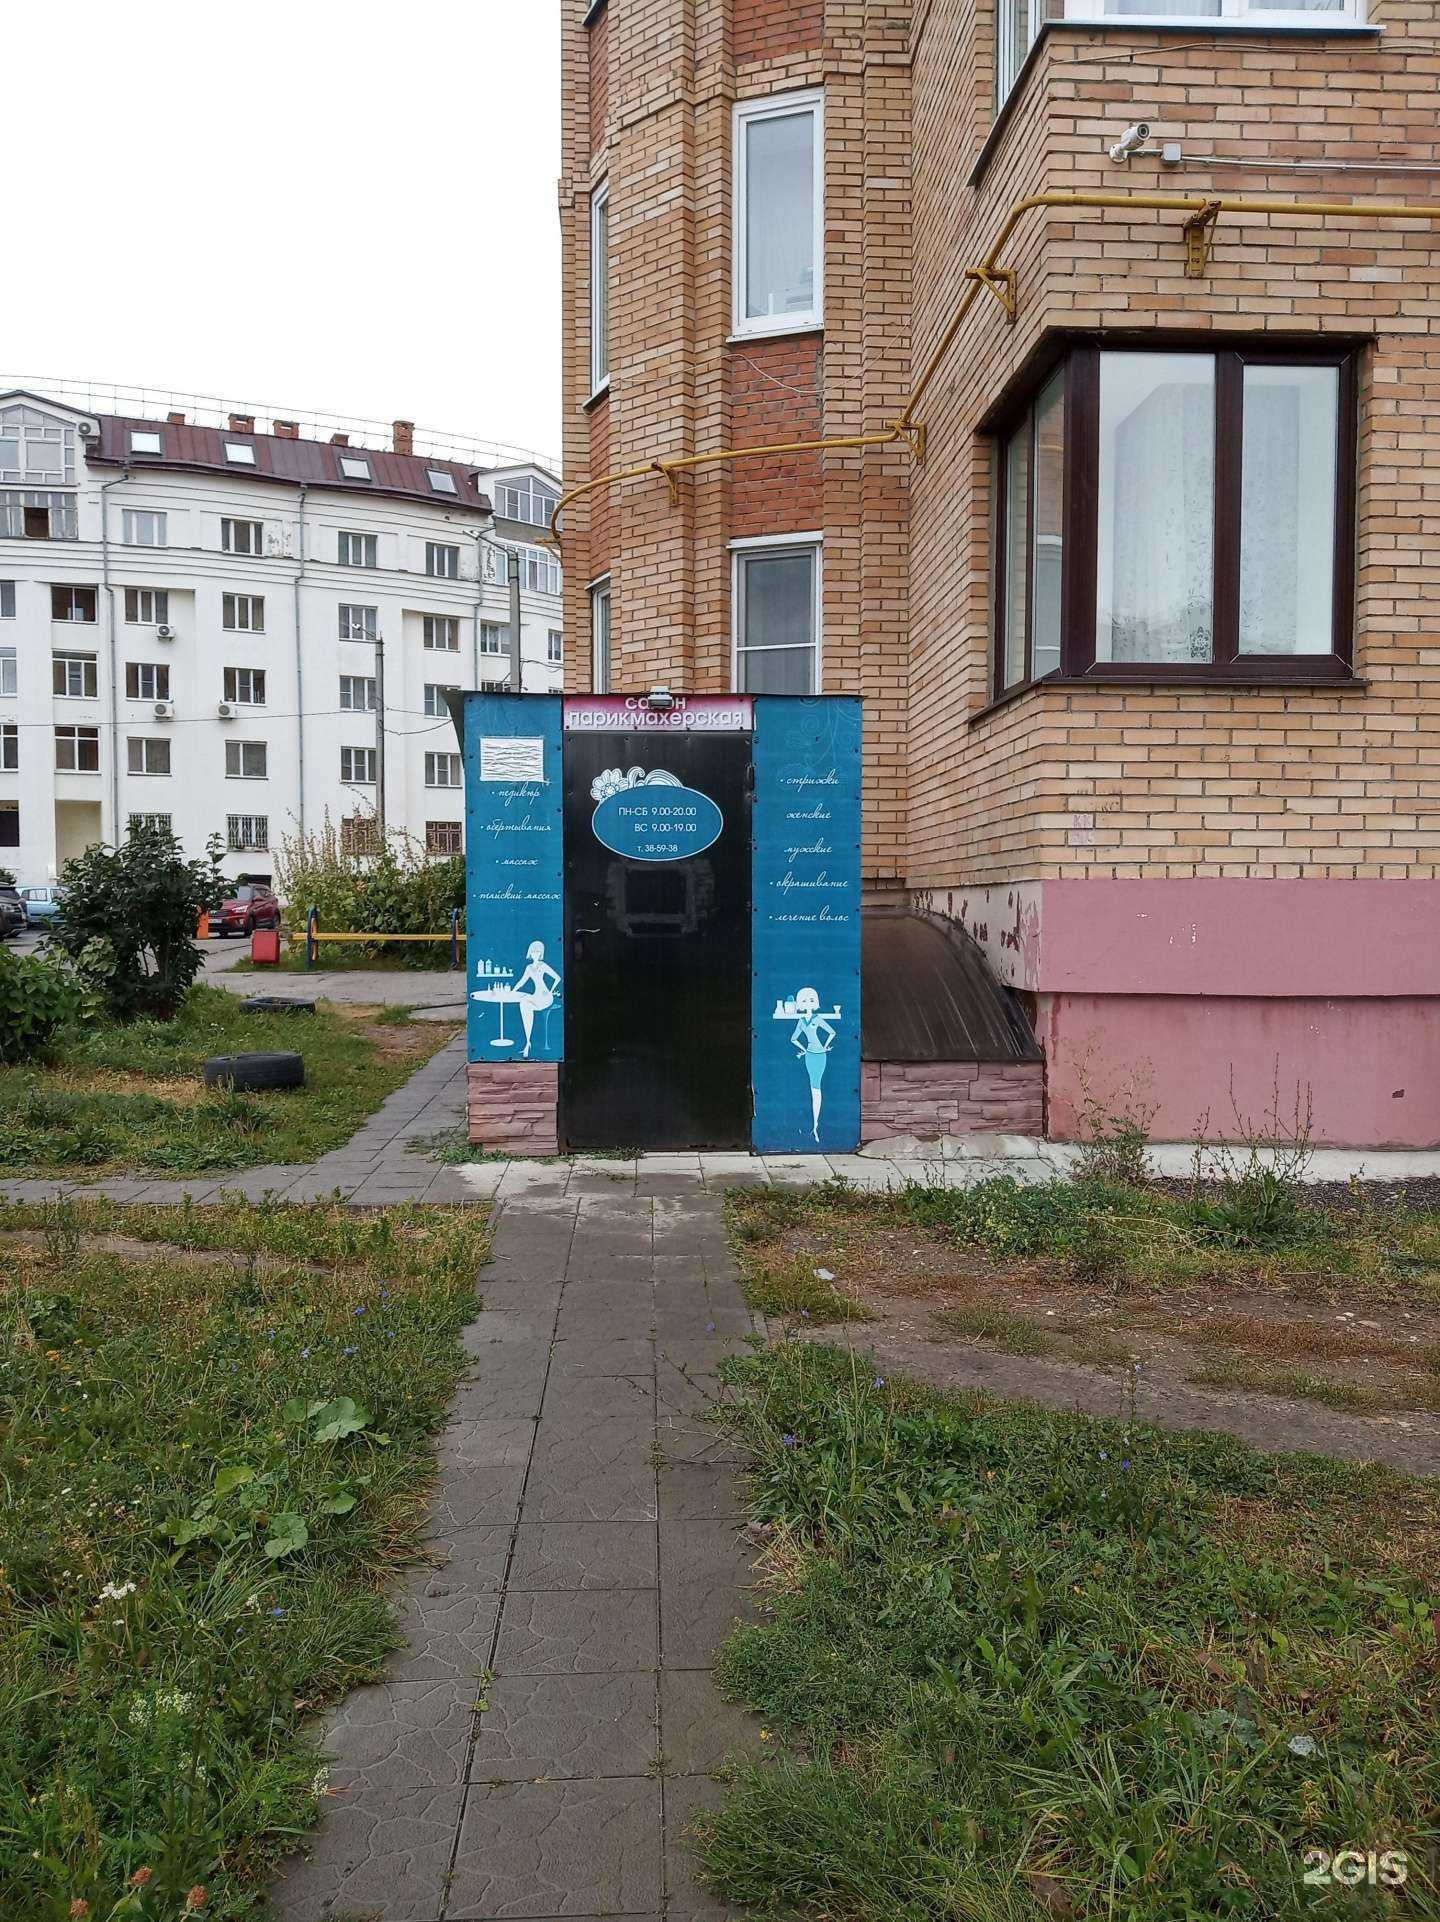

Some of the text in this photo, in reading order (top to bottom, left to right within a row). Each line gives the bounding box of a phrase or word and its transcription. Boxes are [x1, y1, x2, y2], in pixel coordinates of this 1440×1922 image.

[625, 697, 686, 710] сан
[569, 710, 743, 727] парикмахерская
[786, 768, 840, 793] стрижки
[618, 807, 697, 816] ПН-СБ 9.00-20.00
[786, 802, 832, 819] женские
[634, 823, 697, 832] ВС 9.00-19.00
[783, 837, 833, 863] мужские
[479, 883, 522, 899] тайский
[776, 871, 849, 896] окрашивание
[819, 904, 849, 921] волос
